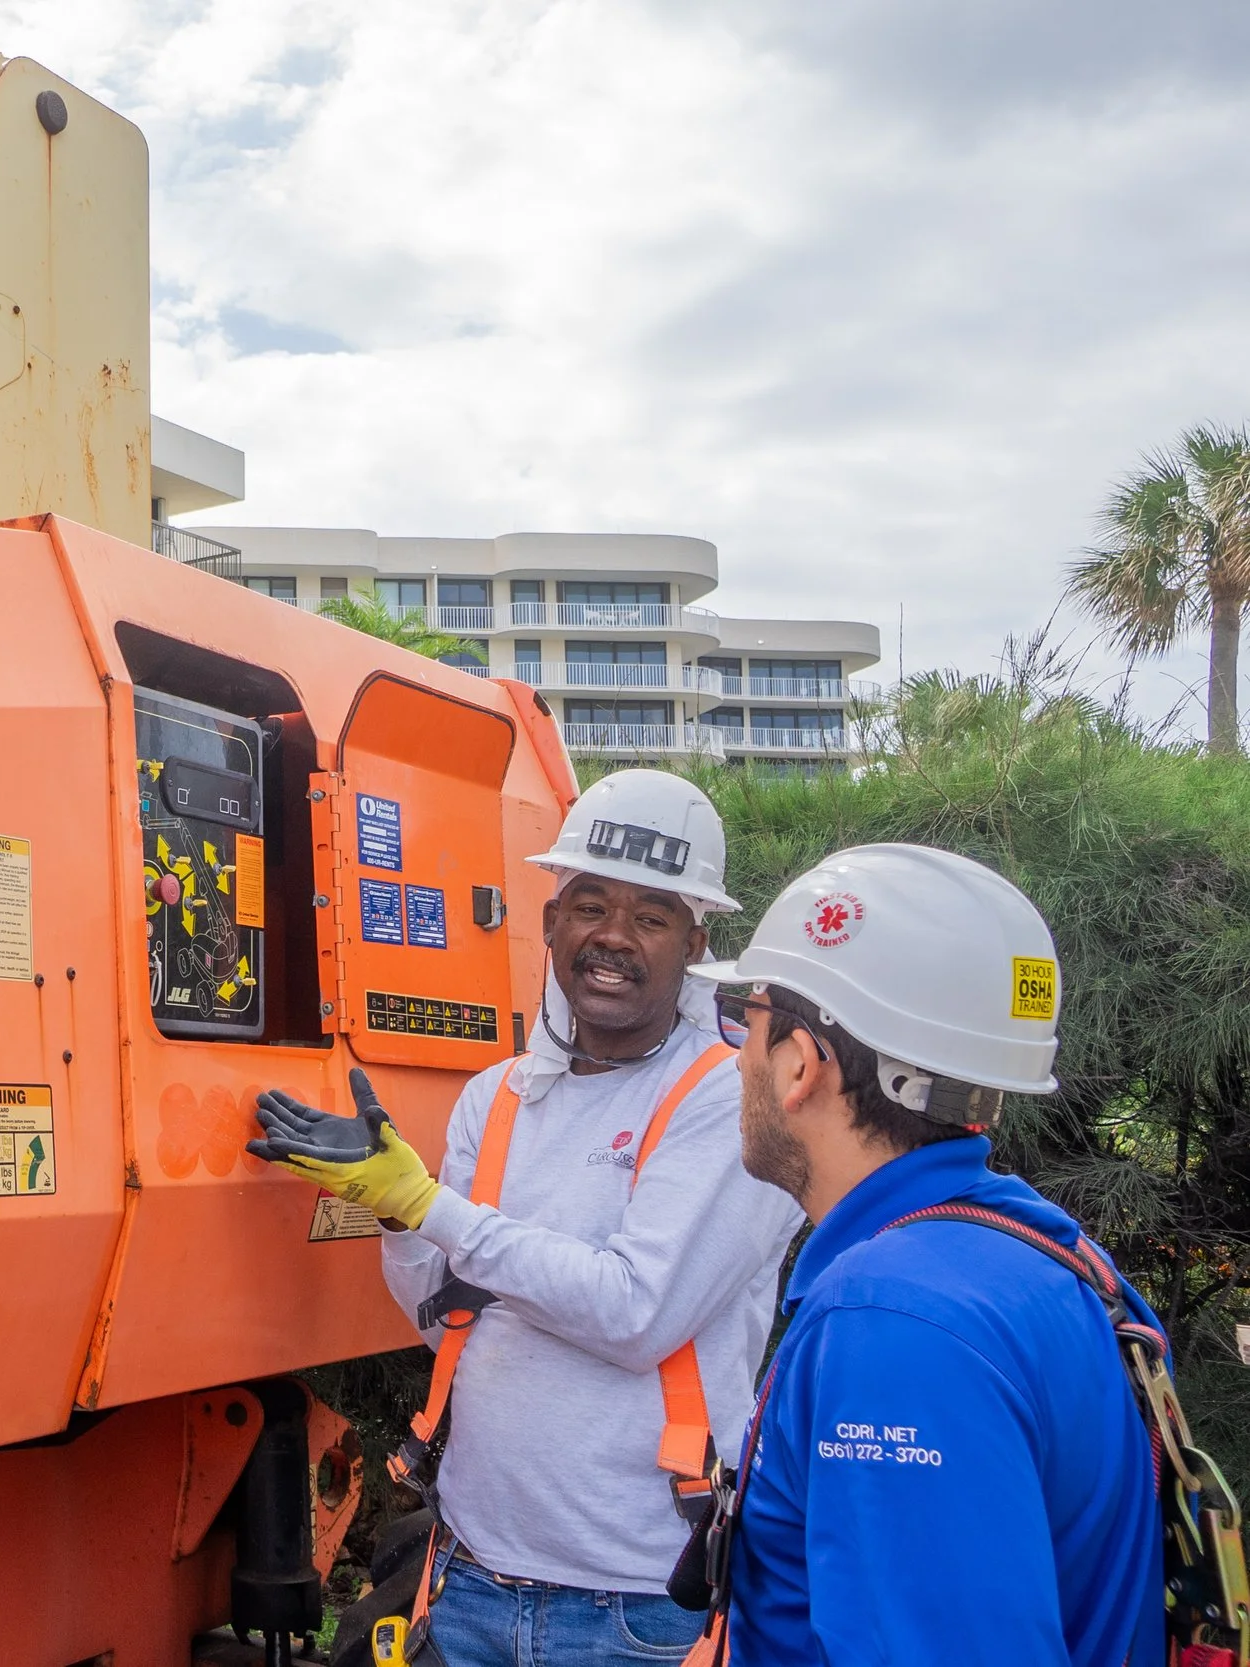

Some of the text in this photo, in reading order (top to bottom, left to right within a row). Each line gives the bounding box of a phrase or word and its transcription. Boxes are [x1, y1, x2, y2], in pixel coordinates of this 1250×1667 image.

[376, 801, 395, 812] United
[376, 809, 397, 821] Rentals
[813, 932, 850, 948] TRAINED
[1019, 964, 1053, 979] 30 HOUR
[168, 987, 191, 1003] JLG
[1019, 979, 1052, 1000] OSHA
[1, 1167, 12, 1178] lbs
[2, 1179, 12, 1191] kg
[818, 1440, 853, 1461] (561)
